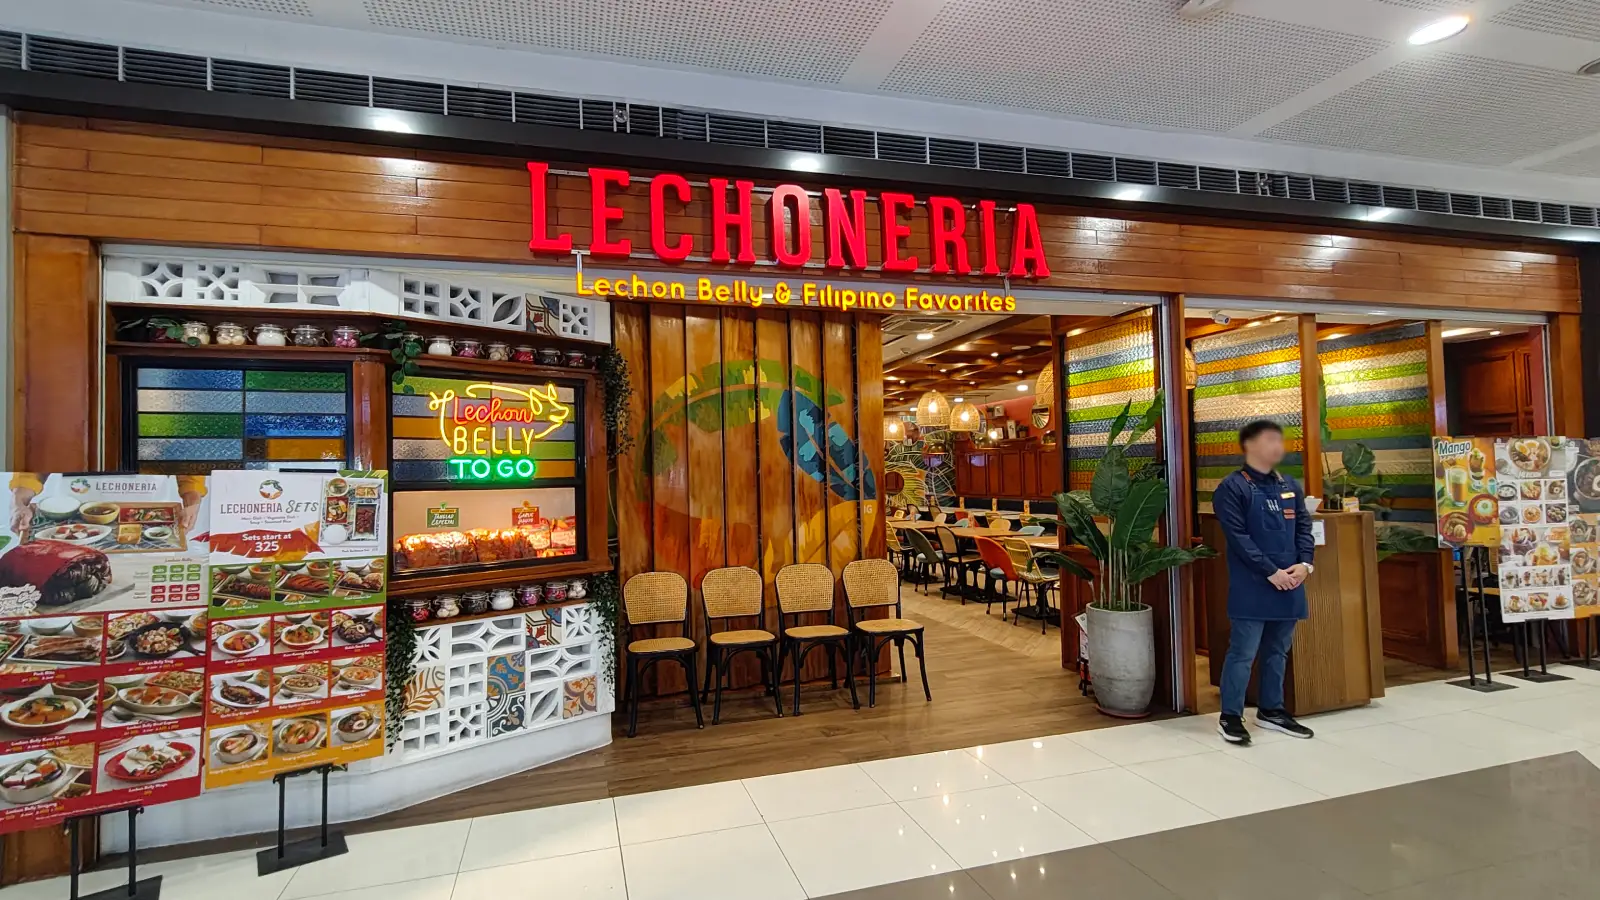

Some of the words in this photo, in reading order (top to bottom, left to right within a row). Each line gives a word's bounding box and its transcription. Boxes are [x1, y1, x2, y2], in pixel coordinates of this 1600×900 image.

[526, 161, 1050, 279] LECHONERIA
[576, 272, 686, 299] Lechon
[698, 277, 764, 306] Belly
[775, 281, 791, 304] &
[803, 281, 897, 310] Filipino
[904, 287, 1017, 312] Favorites
[453, 396, 535, 425] Lechon
[453, 426, 535, 455] BELLY
[1438, 441, 1471, 456] Mango
[449, 458, 491, 480] TO
[496, 458, 535, 478] GO
[96, 482, 157, 491] LECHONERIA
[220, 502, 283, 515] LECHONERIA
[242, 533, 261, 541] Sets
[283, 532, 292, 540] at
[254, 540, 279, 552] 325
